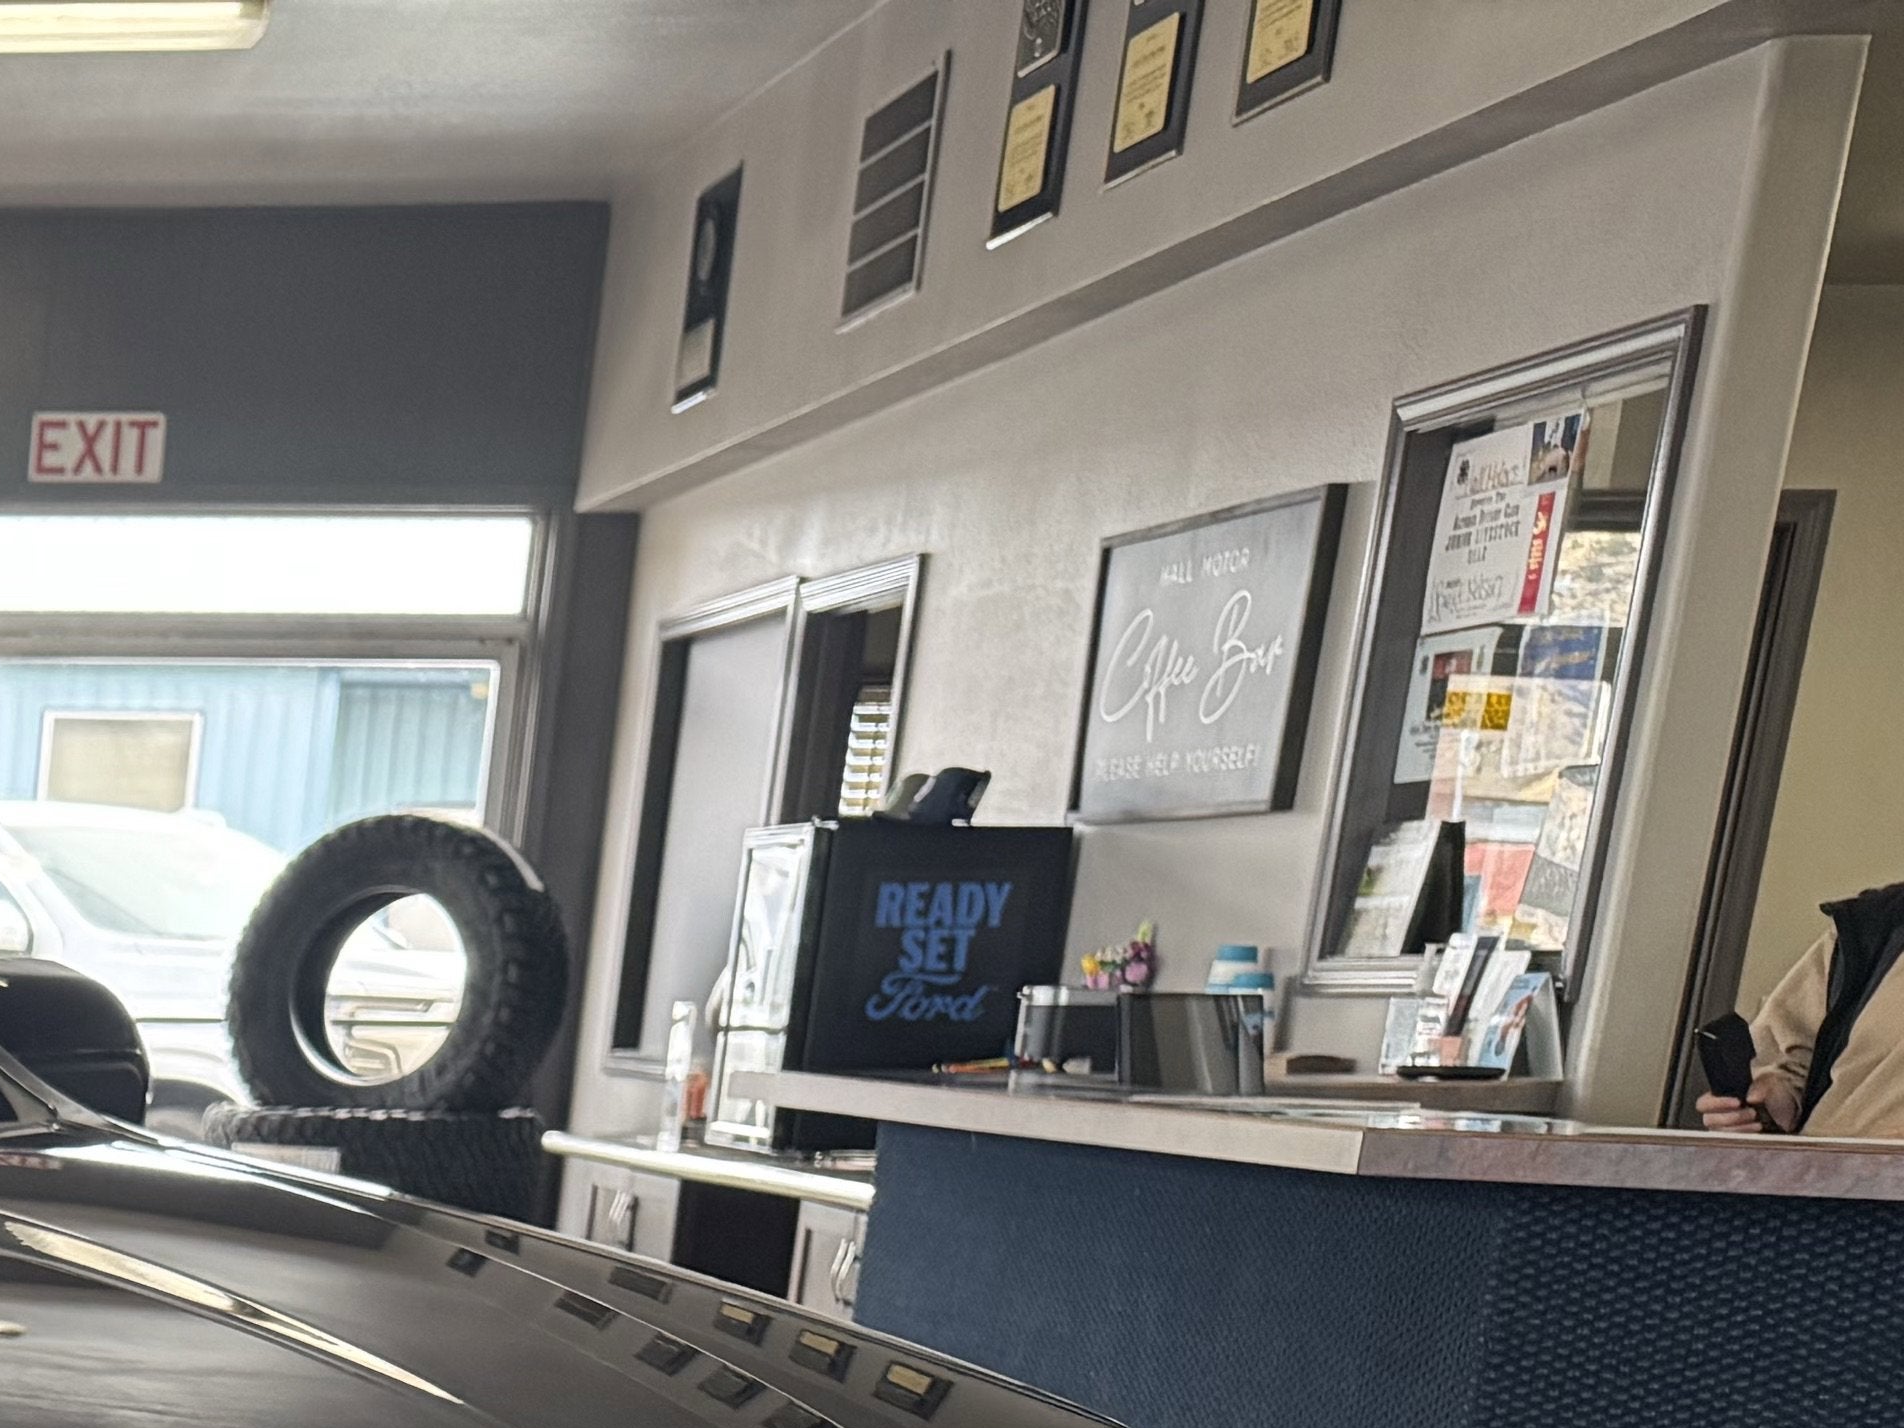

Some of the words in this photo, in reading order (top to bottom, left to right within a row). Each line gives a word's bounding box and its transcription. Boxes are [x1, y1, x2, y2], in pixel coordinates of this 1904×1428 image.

[35, 419, 159, 476] EXIT
[874, 880, 1014, 929] READY
[897, 928, 977, 972] SET
[864, 970, 990, 1022] Ford
